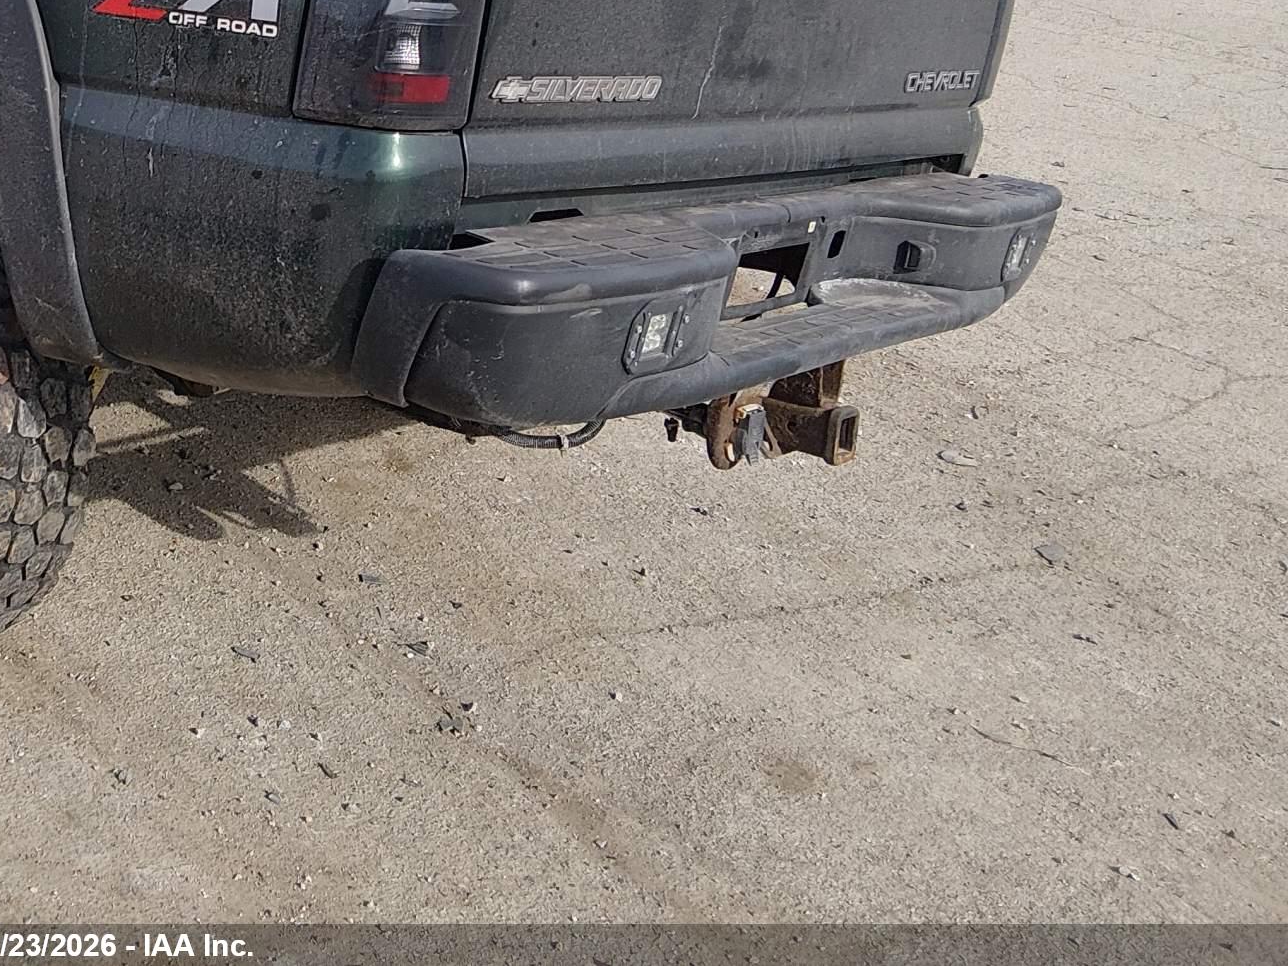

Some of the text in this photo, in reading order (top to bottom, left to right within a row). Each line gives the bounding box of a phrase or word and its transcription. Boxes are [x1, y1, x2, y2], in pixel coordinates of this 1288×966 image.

[168, 11, 279, 38] OFF ROAD
[526, 76, 663, 102] SILVERADO
[905, 69, 981, 93] CHEVROLET
